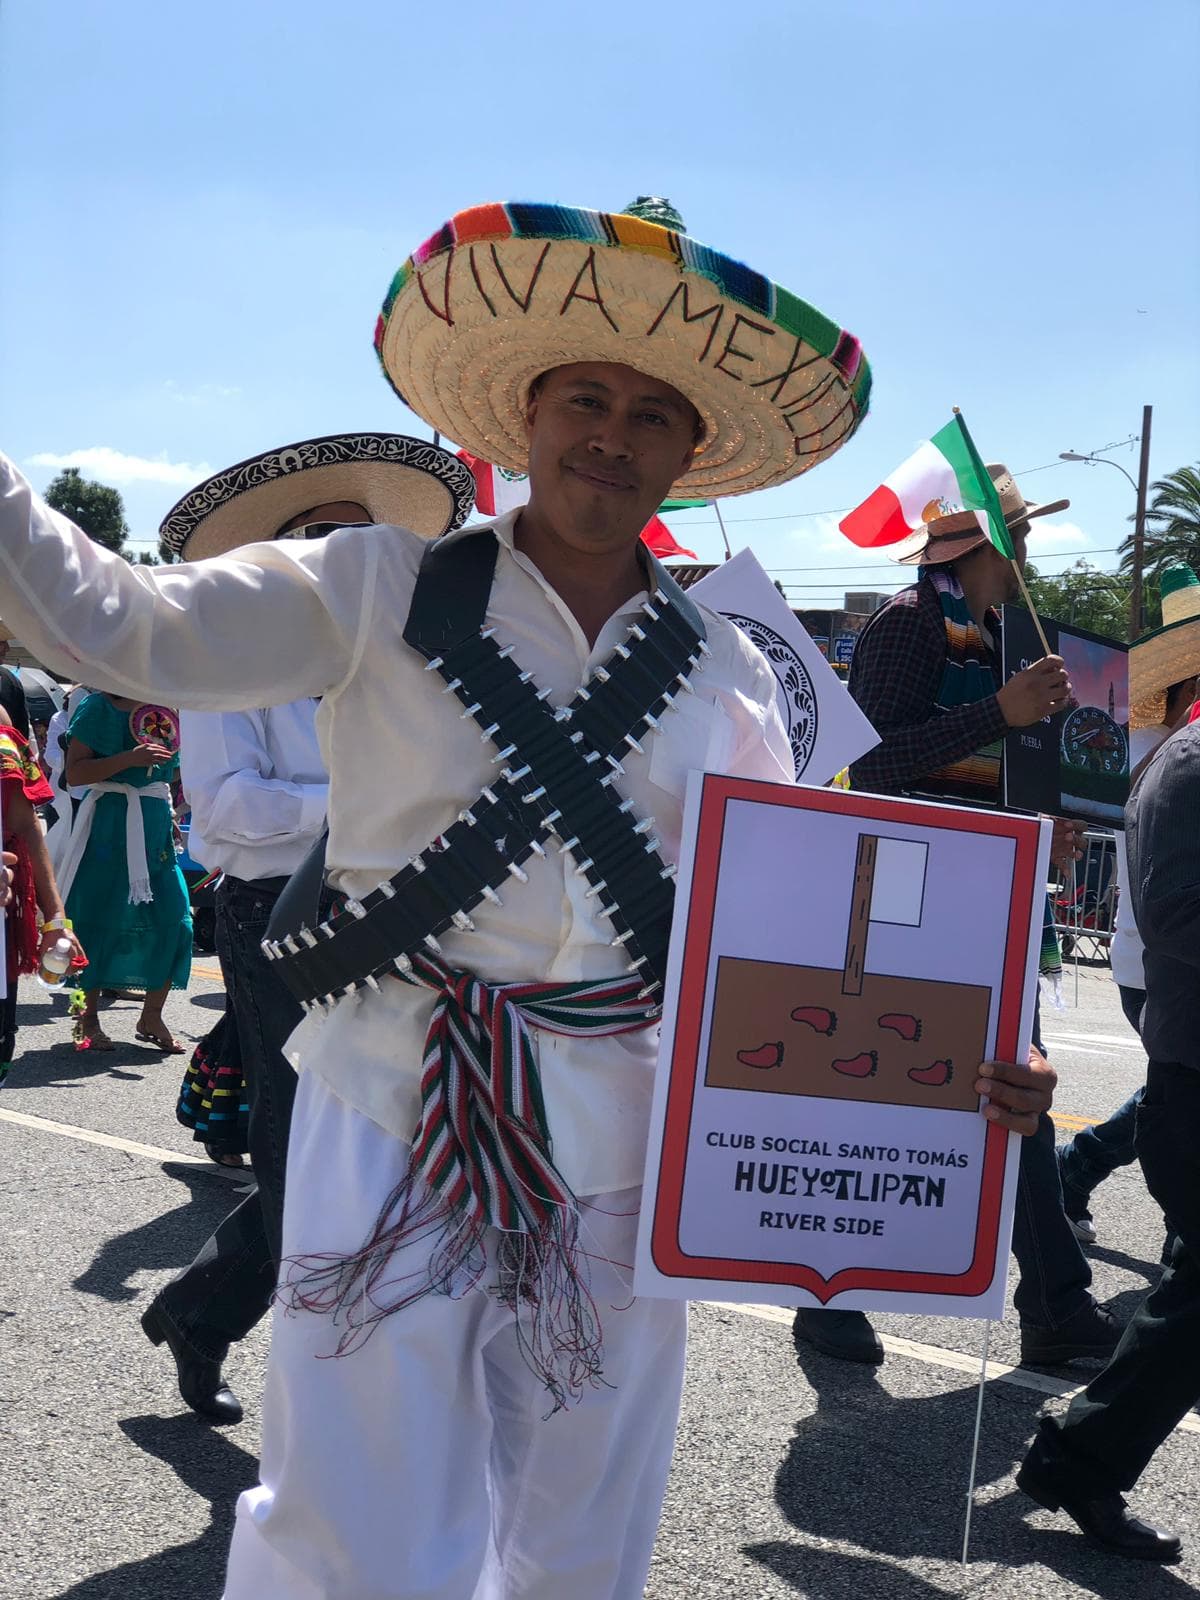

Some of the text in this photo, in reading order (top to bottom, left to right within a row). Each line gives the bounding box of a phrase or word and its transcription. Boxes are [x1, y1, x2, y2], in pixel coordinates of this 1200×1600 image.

[416, 241, 860, 456] VIVA MEXICO
[1072, 727, 1077, 735] 9
[1020, 734, 1042, 750] PUEBLA
[1113, 737, 1119, 745] 3
[1080, 755, 1086, 765] 7
[1112, 751, 1118, 759] 4
[1105, 759, 1111, 770] 5
[706, 1131, 969, 1168] CLUB SOCIAL SANTO TOMÁS
[759, 1211, 885, 1236] RIVER SIDE
